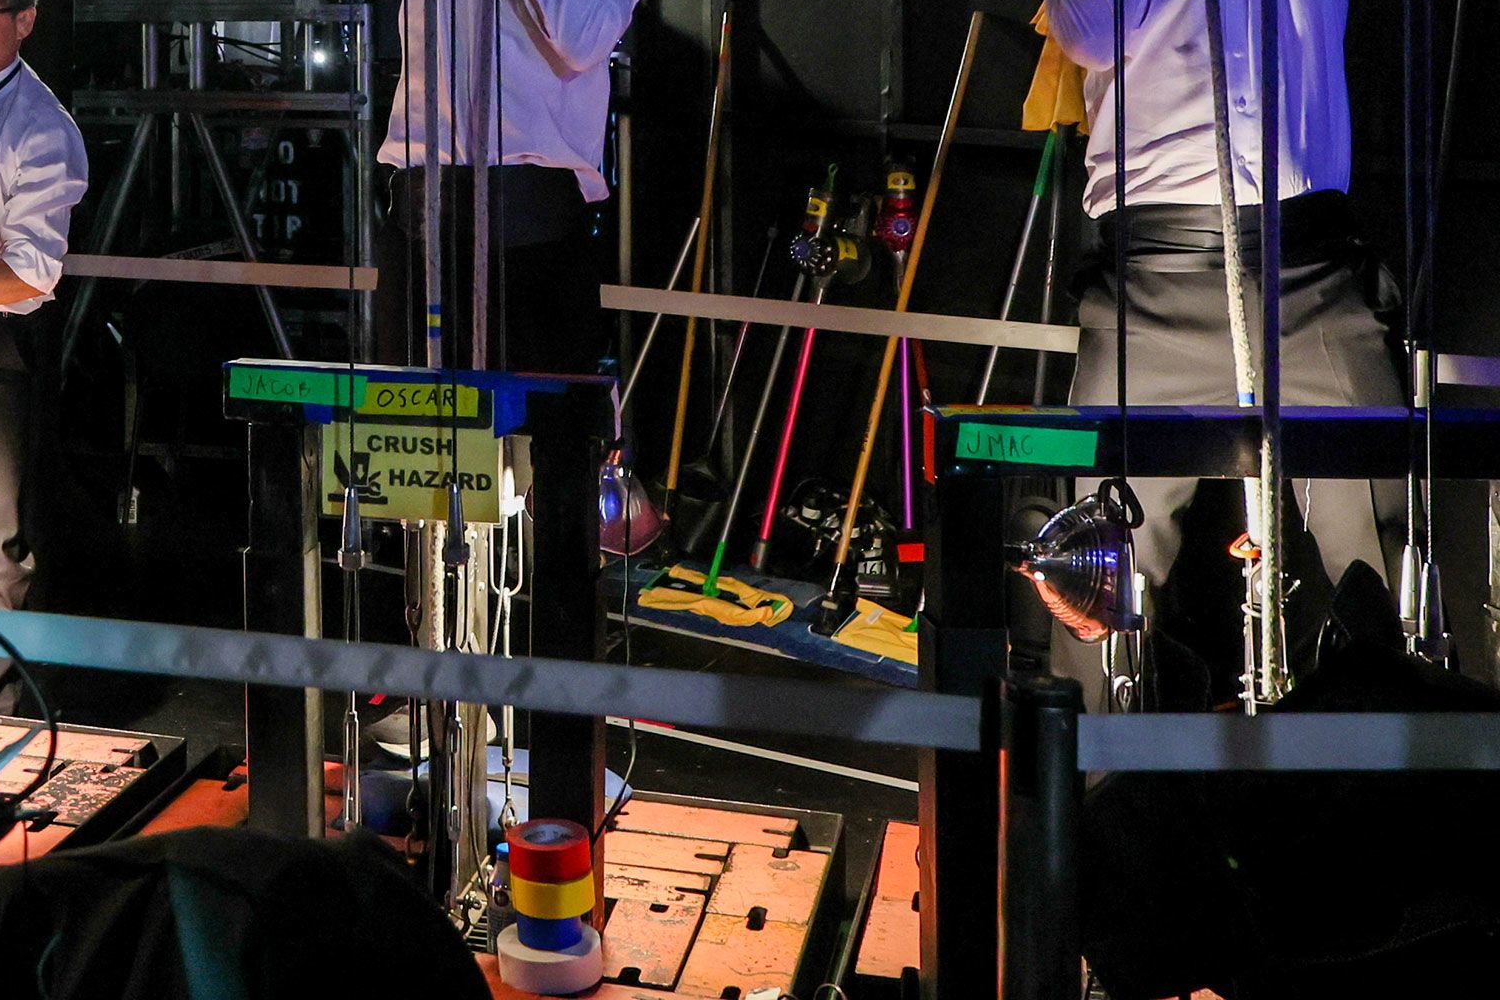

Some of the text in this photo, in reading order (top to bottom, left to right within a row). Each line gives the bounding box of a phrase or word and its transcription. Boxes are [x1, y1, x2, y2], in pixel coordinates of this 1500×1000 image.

[252, 213, 302, 241] TIP
[377, 388, 457, 409] OSCAR
[367, 434, 453, 456] CRUSH
[389, 468, 492, 491] HAZARD
